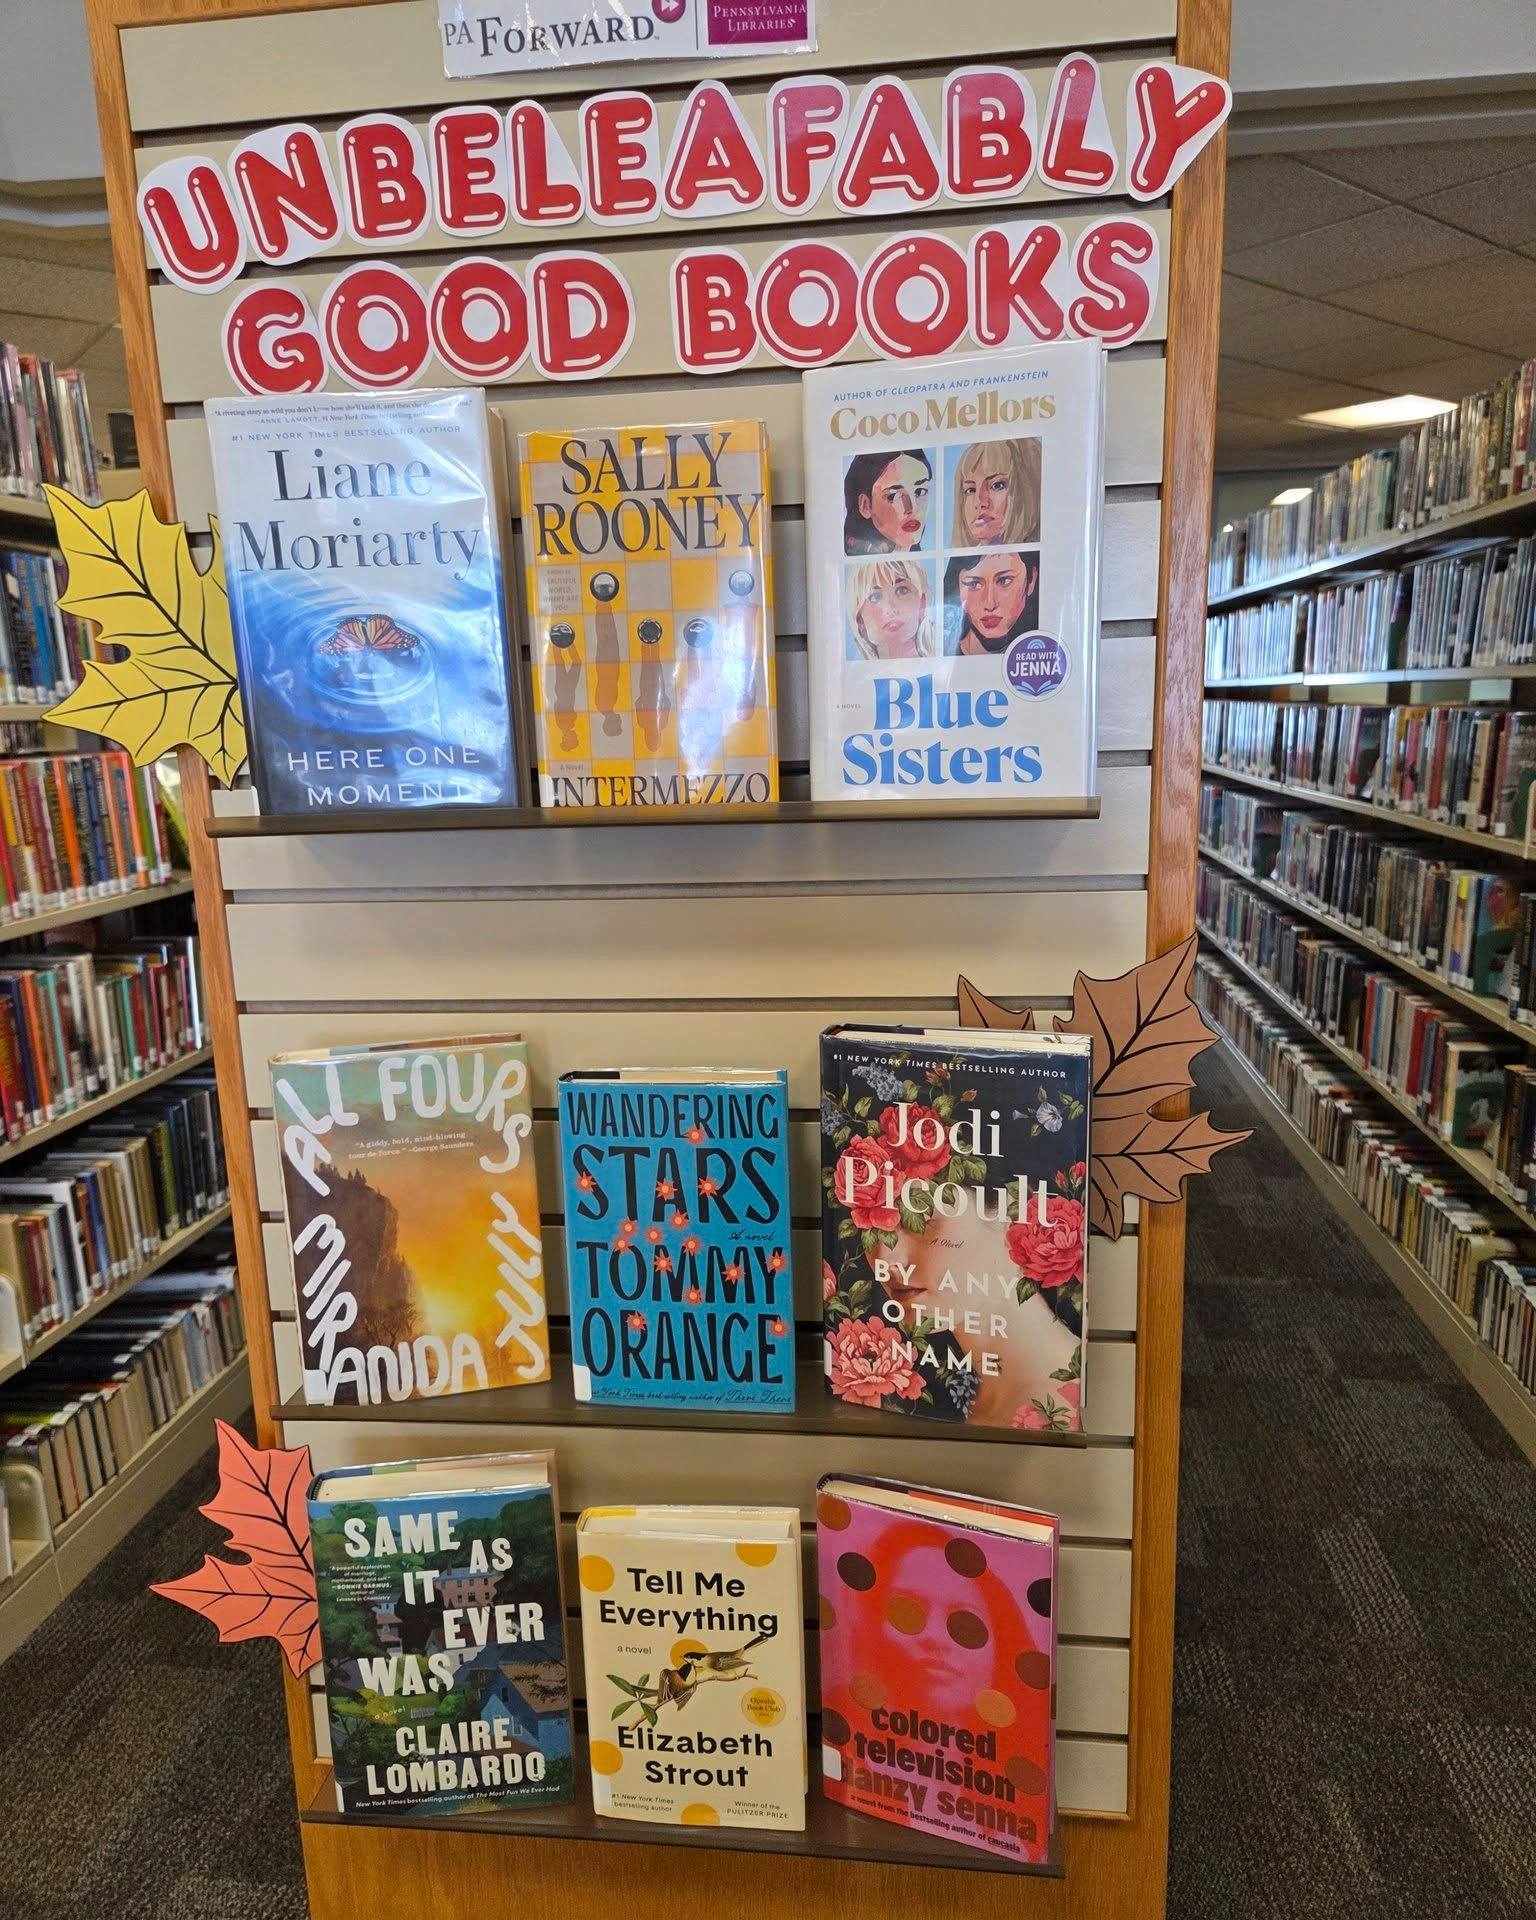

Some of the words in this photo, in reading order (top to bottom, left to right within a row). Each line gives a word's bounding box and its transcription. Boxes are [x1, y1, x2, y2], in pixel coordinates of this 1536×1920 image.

[713, 3, 806, 18] PENNSYLVANIA
[727, 19, 795, 32] LIBRARIES
[445, 21, 474, 45] PA
[477, 16, 655, 57] FORWARD
[141, 57, 1227, 286] UNBELEAFABLY
[676, 222, 1153, 367] BOOKS
[227, 258, 632, 395] GOOD
[833, 391, 872, 402] AUTHOR
[875, 389, 888, 398] OF
[891, 382, 946, 395] CLEOPATRA
[949, 379, 971, 389] AND
[972, 371, 1050, 387] FRANKENSTEIN
[248, 433, 271, 441] NEW
[276, 432, 304, 440] YORK
[308, 431, 339, 439] TIMES
[419, 425, 461, 434] AUTHOR
[830, 407, 920, 441] Coco
[924, 391, 1057, 433] Mellors
[267, 448, 432, 501] Liane
[560, 432, 732, 495] SALLY
[533, 493, 765, 556] ROONEY
[233, 517, 480, 581] Moriarty
[1010, 660, 1062, 677] JENNA
[1016, 652, 1037, 661] READ
[1038, 652, 1060, 660] WITH
[873, 674, 1009, 730] Blue
[287, 748, 385, 771] HERE
[405, 745, 480, 766] ONE
[842, 732, 1043, 786] Sisters
[307, 782, 464, 806] MOMENT
[552, 772, 771, 807] INTERMEZZO
[847, 1054, 869, 1063] NEW
[874, 1056, 901, 1067] YORK
[906, 1059, 937, 1069] TIMES
[941, 1061, 1015, 1076] BESTSELLING
[1020, 1067, 1067, 1079] AUTHOR
[276, 1063, 359, 1198] ALL
[378, 1053, 532, 1174] FOURS
[567, 1091, 779, 1140] WANDERING
[887, 1101, 1004, 1158] Jodi
[573, 1143, 780, 1224] STARS
[840, 1154, 1059, 1228] Picoult
[487, 1191, 546, 1380] JULY
[576, 1241, 784, 1304] TOMMY
[874, 1258, 917, 1286] BY
[938, 1268, 1019, 1300] ANY
[293, 1214, 488, 1406] MIRANDA
[882, 1300, 1009, 1339] OTHER
[582, 1307, 783, 1384] ORANGE
[891, 1338, 1000, 1377] NAME
[343, 1510, 461, 1558] SAME
[469, 1537, 514, 1574] AS
[403, 1570, 440, 1605] IT
[627, 1567, 683, 1595] Tell
[695, 1571, 746, 1598] Me
[442, 1602, 545, 1649] EVER
[599, 1600, 778, 1638] Everything
[625, 1644, 652, 1655] novel
[357, 1652, 455, 1697] WAS
[382, 1704, 406, 1718] novel
[394, 1717, 512, 1757] CLAIRE
[618, 1725, 773, 1757] Elizabeth
[871, 1707, 996, 1761] colored
[366, 1750, 546, 1796] LOMBARDO
[645, 1760, 748, 1787] Strout
[854, 1731, 1016, 1804] television
[372, 1799, 386, 1807] York
[407, 1796, 443, 1805] bestselling
[476, 1791, 488, 1799] The
[489, 1790, 505, 1798] Most
[531, 1786, 545, 1794] Ever
[545, 1785, 560, 1793] Had
[613, 1801, 650, 1811] bestselling
[653, 1797, 674, 1805] Times
[726, 1808, 764, 1816] PULITZER
[766, 1811, 789, 1819] PRIZE
[734, 1800, 759, 1809] Winner
[937, 1790, 1037, 1845] senna
[857, 1796, 877, 1808] novel
[877, 1801, 895, 1814] from
[897, 1806, 909, 1817] the
[910, 1810, 950, 1831] bestselling
[951, 1824, 976, 1838] author
[987, 1835, 1021, 1853] caucasia
